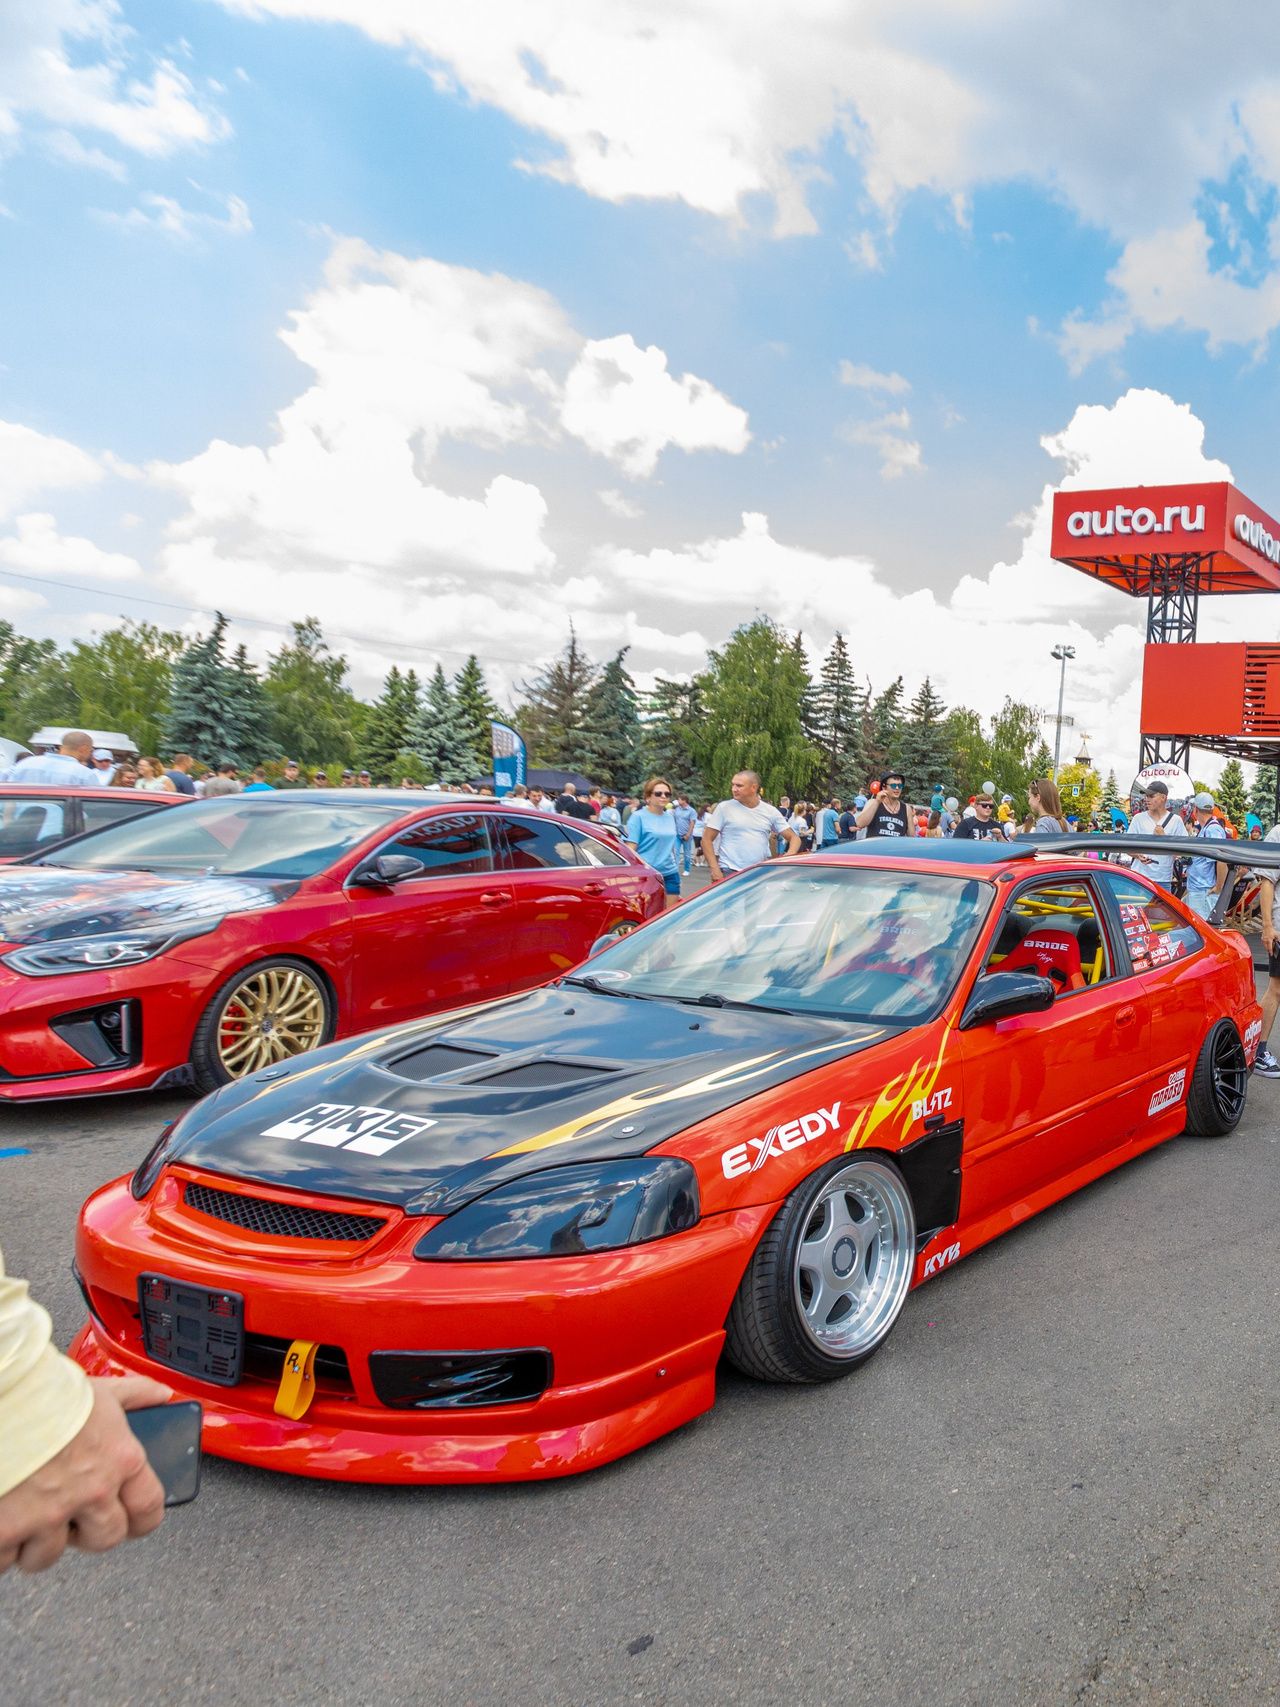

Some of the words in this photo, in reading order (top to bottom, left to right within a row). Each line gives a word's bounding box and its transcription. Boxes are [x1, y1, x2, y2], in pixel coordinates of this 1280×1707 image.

[1067, 505, 1206, 537] auto.ru
[1140, 768, 1180, 778] auto.ru
[881, 926, 919, 935] BRIDE
[1023, 940, 1070, 952] BRIDE
[911, 1087, 953, 1121] BLITZ
[268, 1103, 435, 1151] HKS
[721, 1101, 841, 1180] EXEDY
[923, 1241, 961, 1278] KYB
